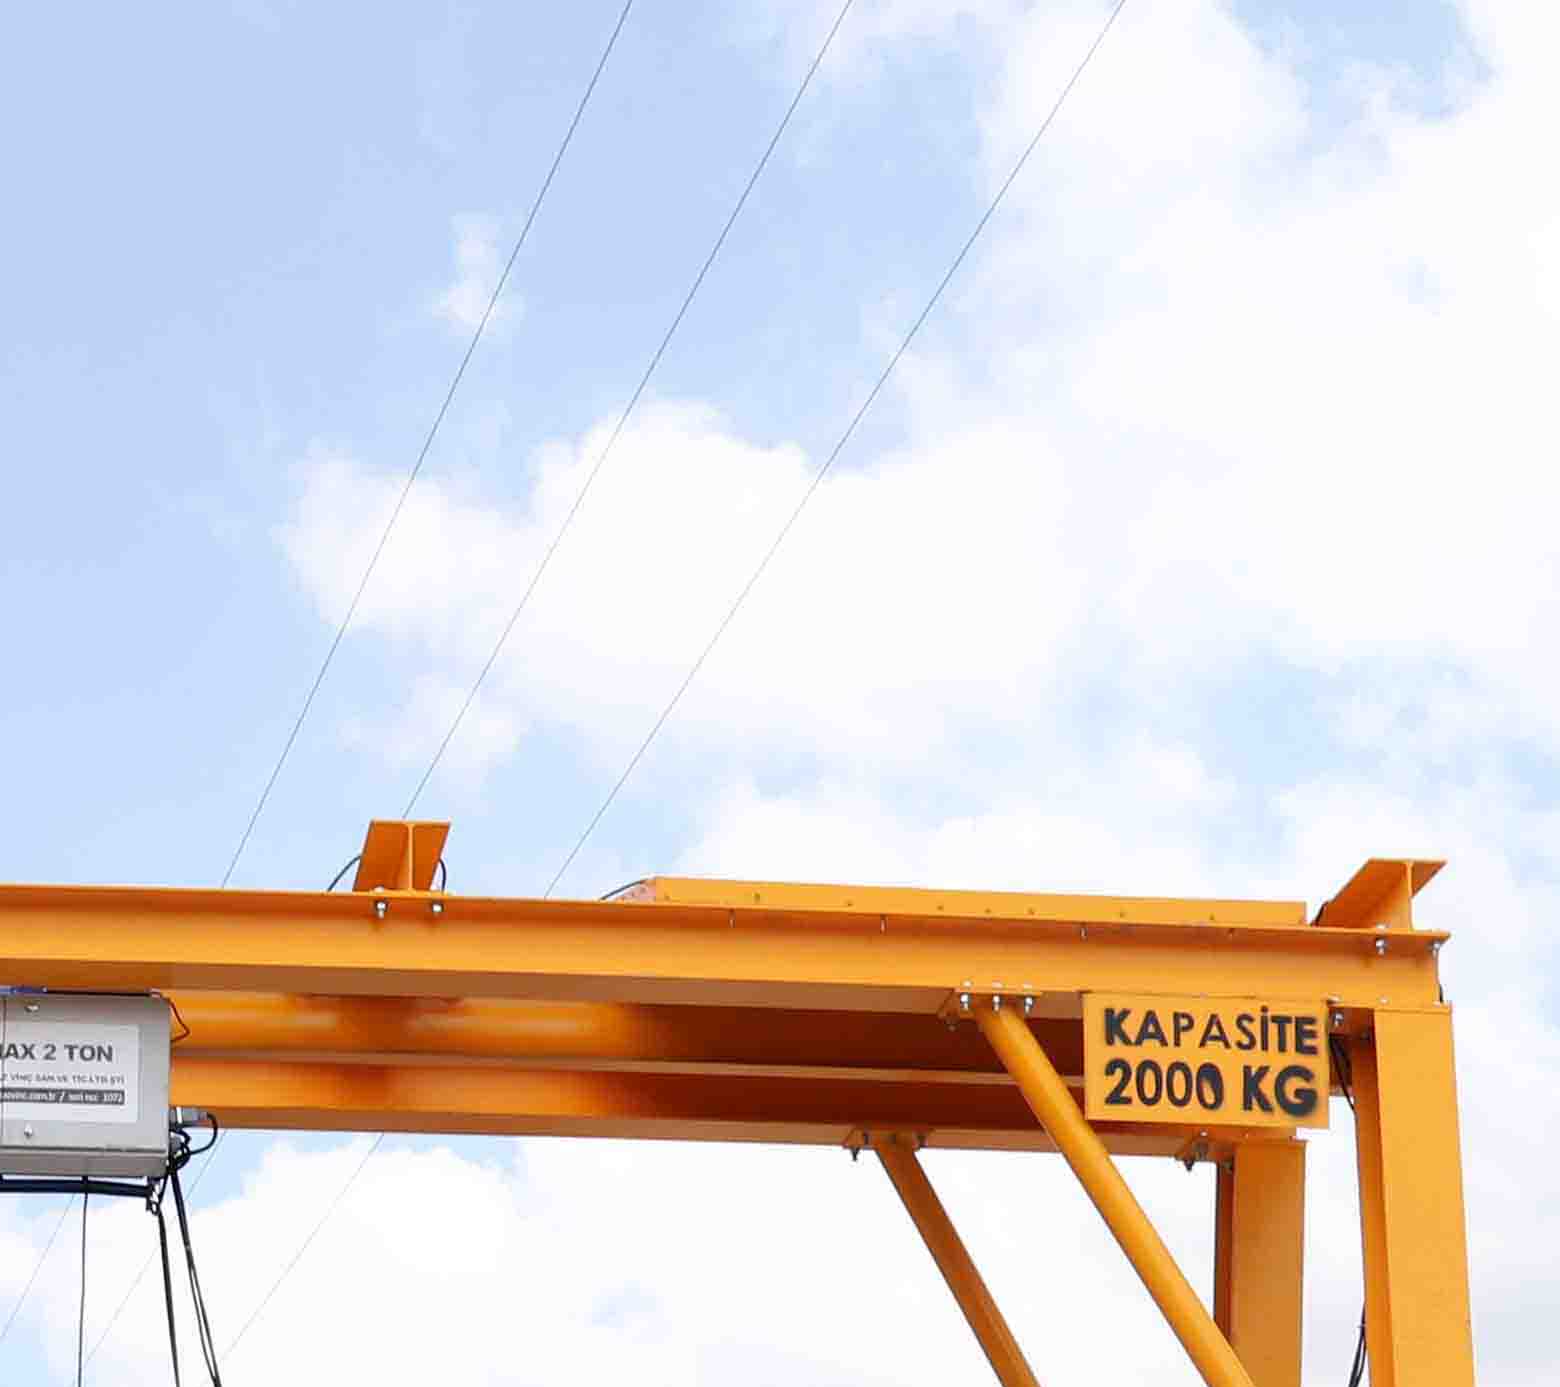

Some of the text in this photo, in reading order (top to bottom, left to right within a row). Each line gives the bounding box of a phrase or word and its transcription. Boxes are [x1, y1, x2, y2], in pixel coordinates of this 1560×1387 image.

[43, 1043, 58, 1061] 2
[63, 1044, 114, 1063] TON
[1104, 1006, 1318, 1055] KAPASİTE
[1104, 1058, 1318, 1117] 2000 KG
